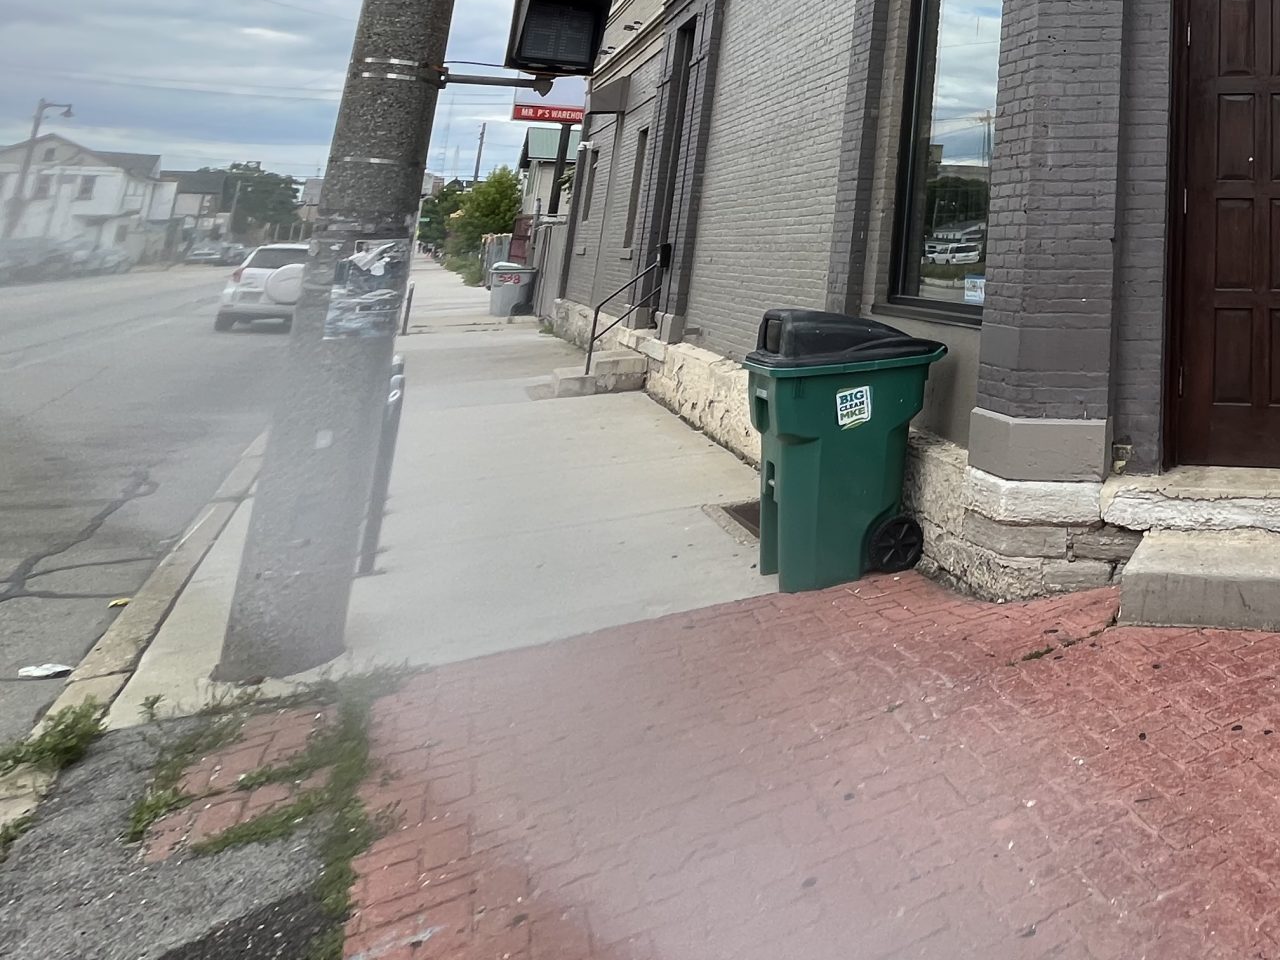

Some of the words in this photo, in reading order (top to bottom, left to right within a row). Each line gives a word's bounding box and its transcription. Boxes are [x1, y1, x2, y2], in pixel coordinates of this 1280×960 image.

[520, 108, 535, 117] MR.
[536, 109, 550, 118] P'S
[838, 390, 865, 406] BIG
[839, 400, 865, 412] CLEAN
[839, 407, 866, 421] MKE
